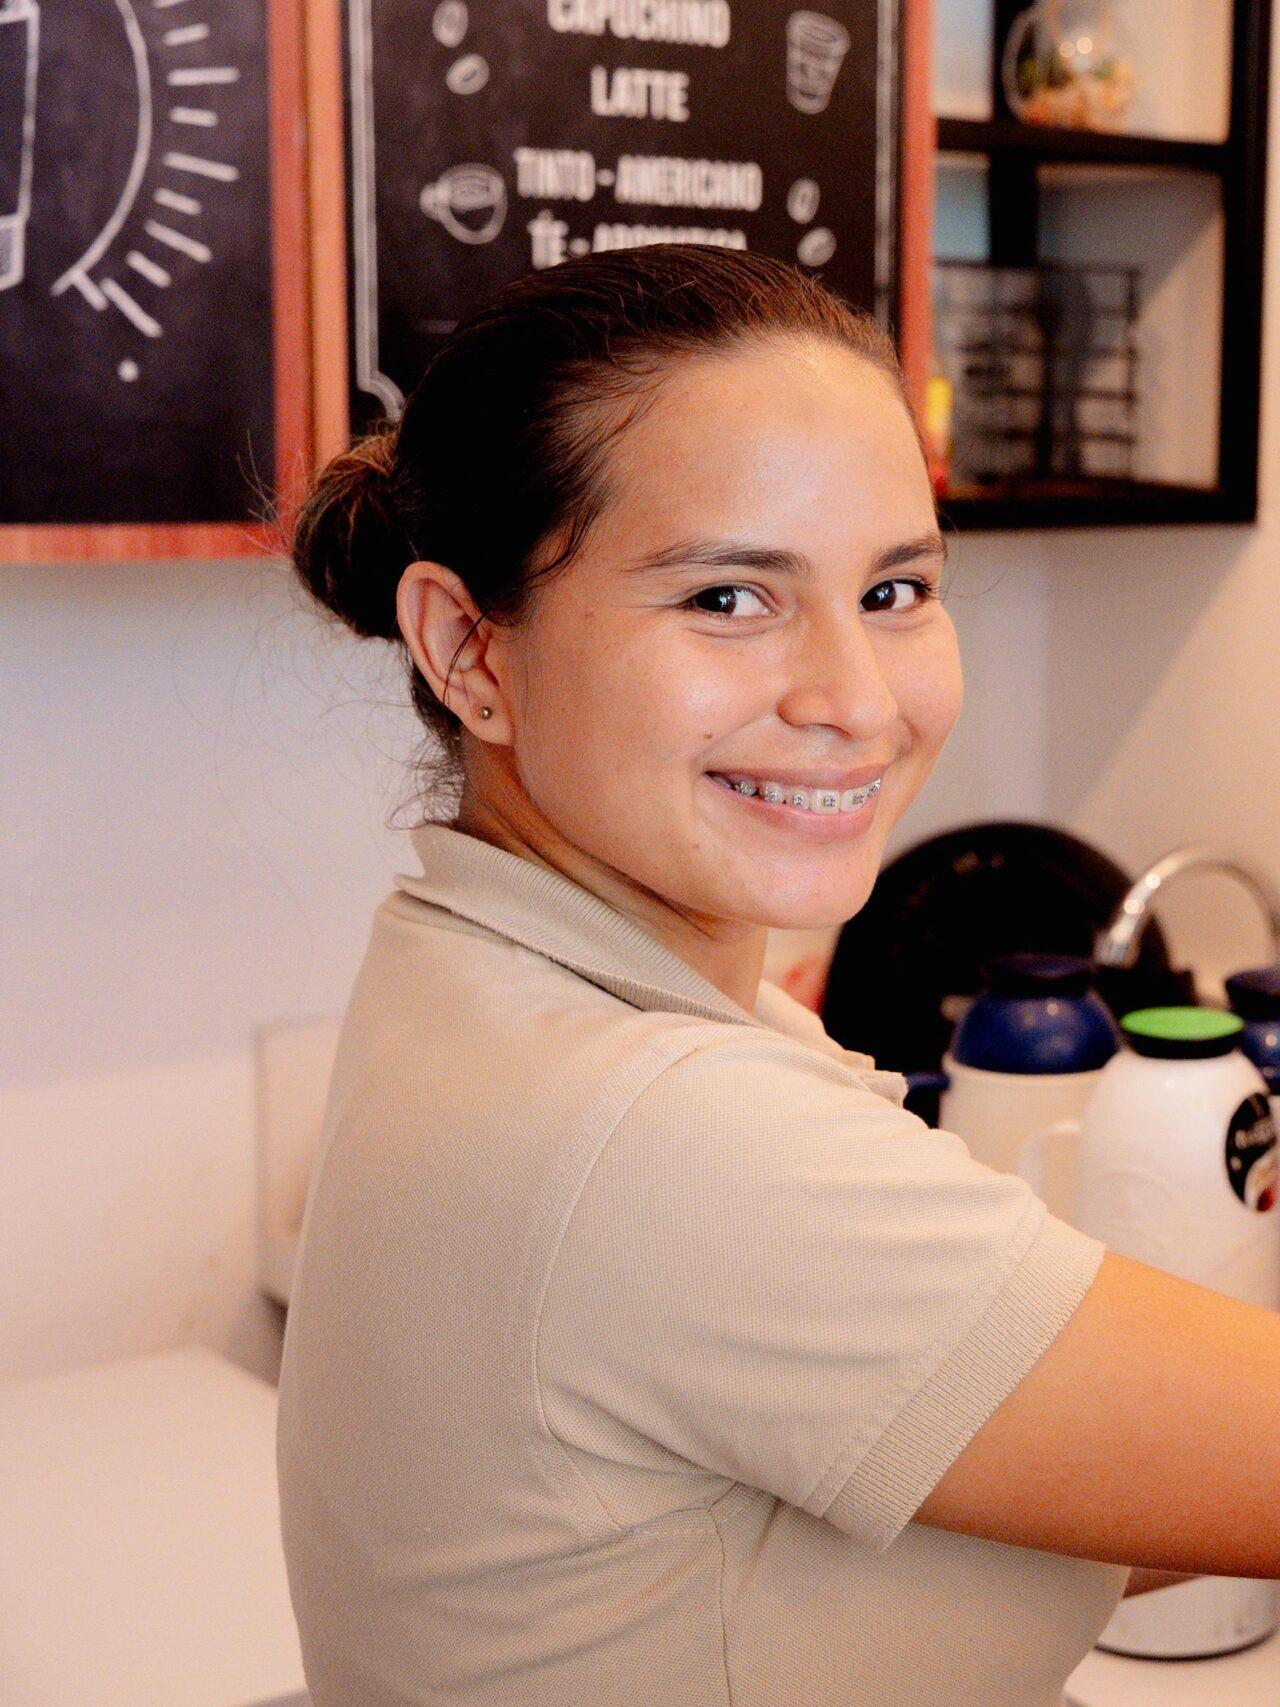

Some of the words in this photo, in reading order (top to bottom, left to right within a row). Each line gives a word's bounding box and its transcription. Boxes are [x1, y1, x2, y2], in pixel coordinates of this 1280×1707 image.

[591, 65, 690, 122] LATTE
[514, 147, 596, 201] TINTO
[615, 154, 763, 211] AMERICANO
